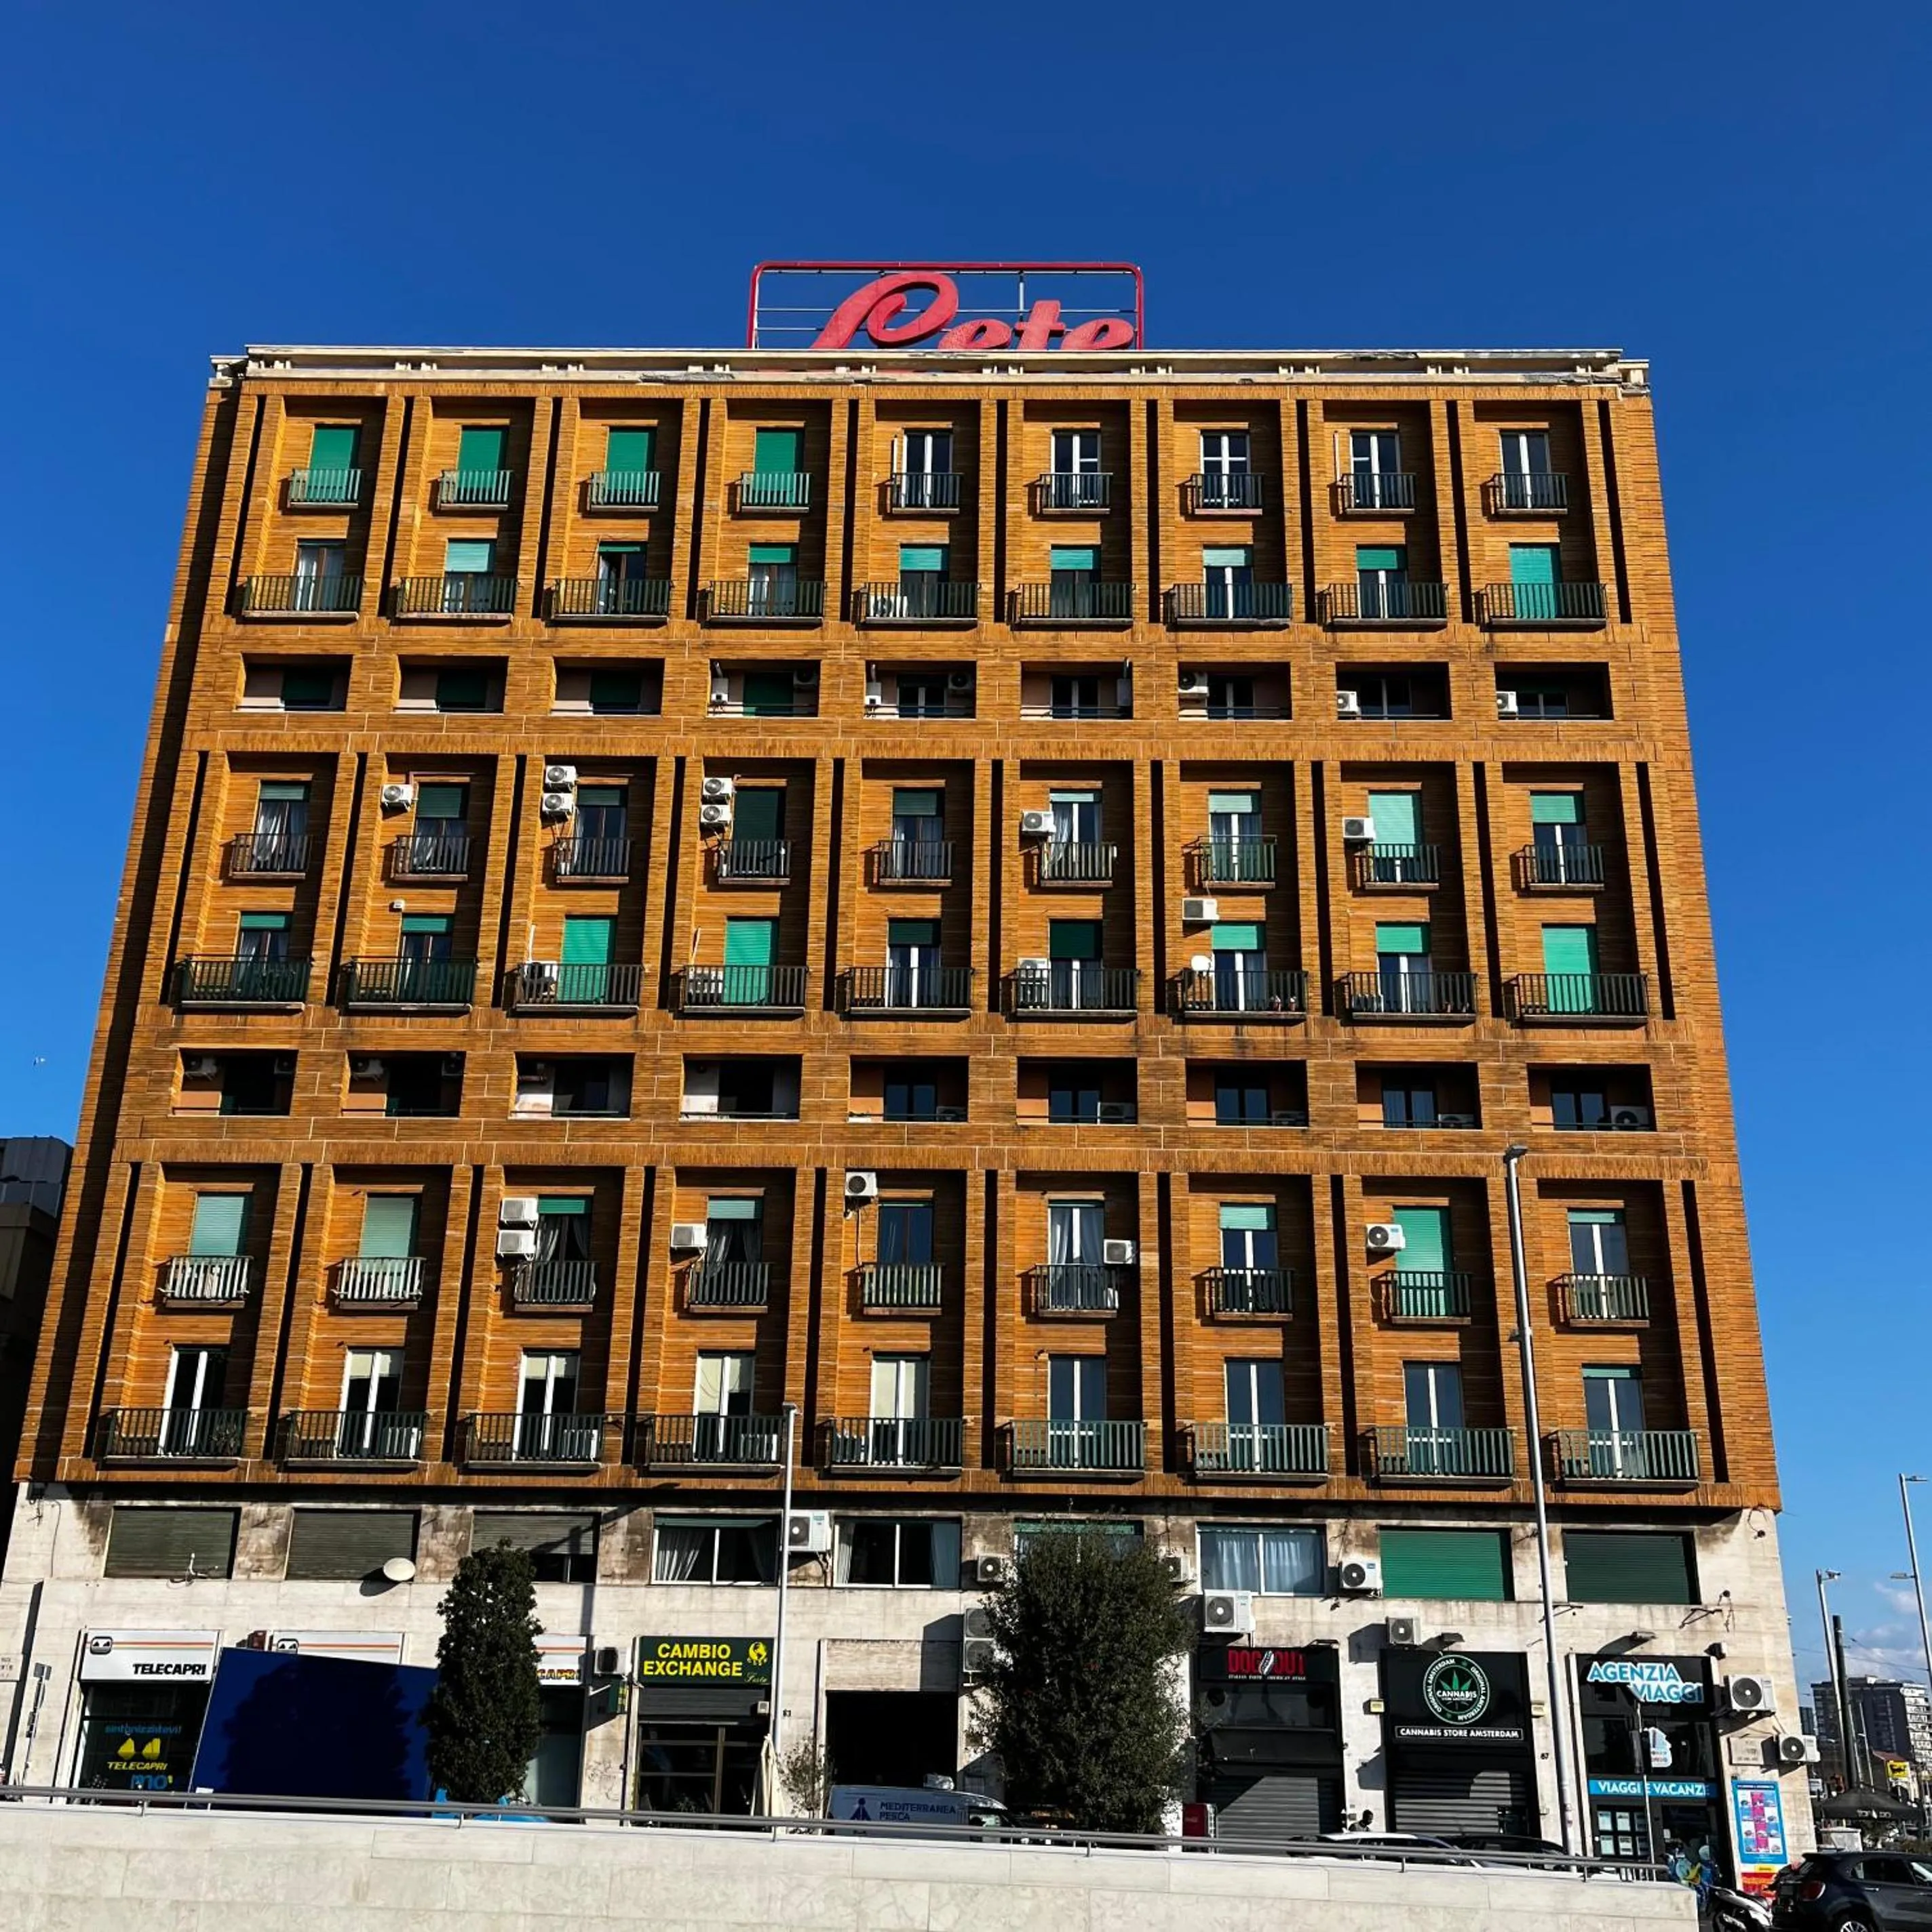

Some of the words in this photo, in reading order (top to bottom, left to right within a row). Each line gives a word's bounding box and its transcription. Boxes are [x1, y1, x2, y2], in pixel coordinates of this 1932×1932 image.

[657, 1643, 731, 1659] CAMBIO
[132, 1663, 206, 1675] TELECAPRI
[643, 1661, 743, 1676] EXCHANGE
[1229, 1650, 1262, 1674] DOG
[1428, 1659, 1456, 1684] AMSTERDAM
[1588, 1663, 1680, 1682] AGENZIA
[1436, 1690, 1477, 1699] CANNABIS
[1632, 1683, 1703, 1702] VIAGGI
[1400, 1728, 1442, 1737] CANNABIS
[1444, 1729, 1467, 1737] STORE
[1469, 1730, 1519, 1738] AMSTERDAM
[107, 1761, 168, 1771] TELECAPRI
[1598, 1781, 1640, 1794] VIAGGI
[880, 1801, 956, 1815] MEDITERRANEA
[880, 1812, 910, 1821] PESCA
